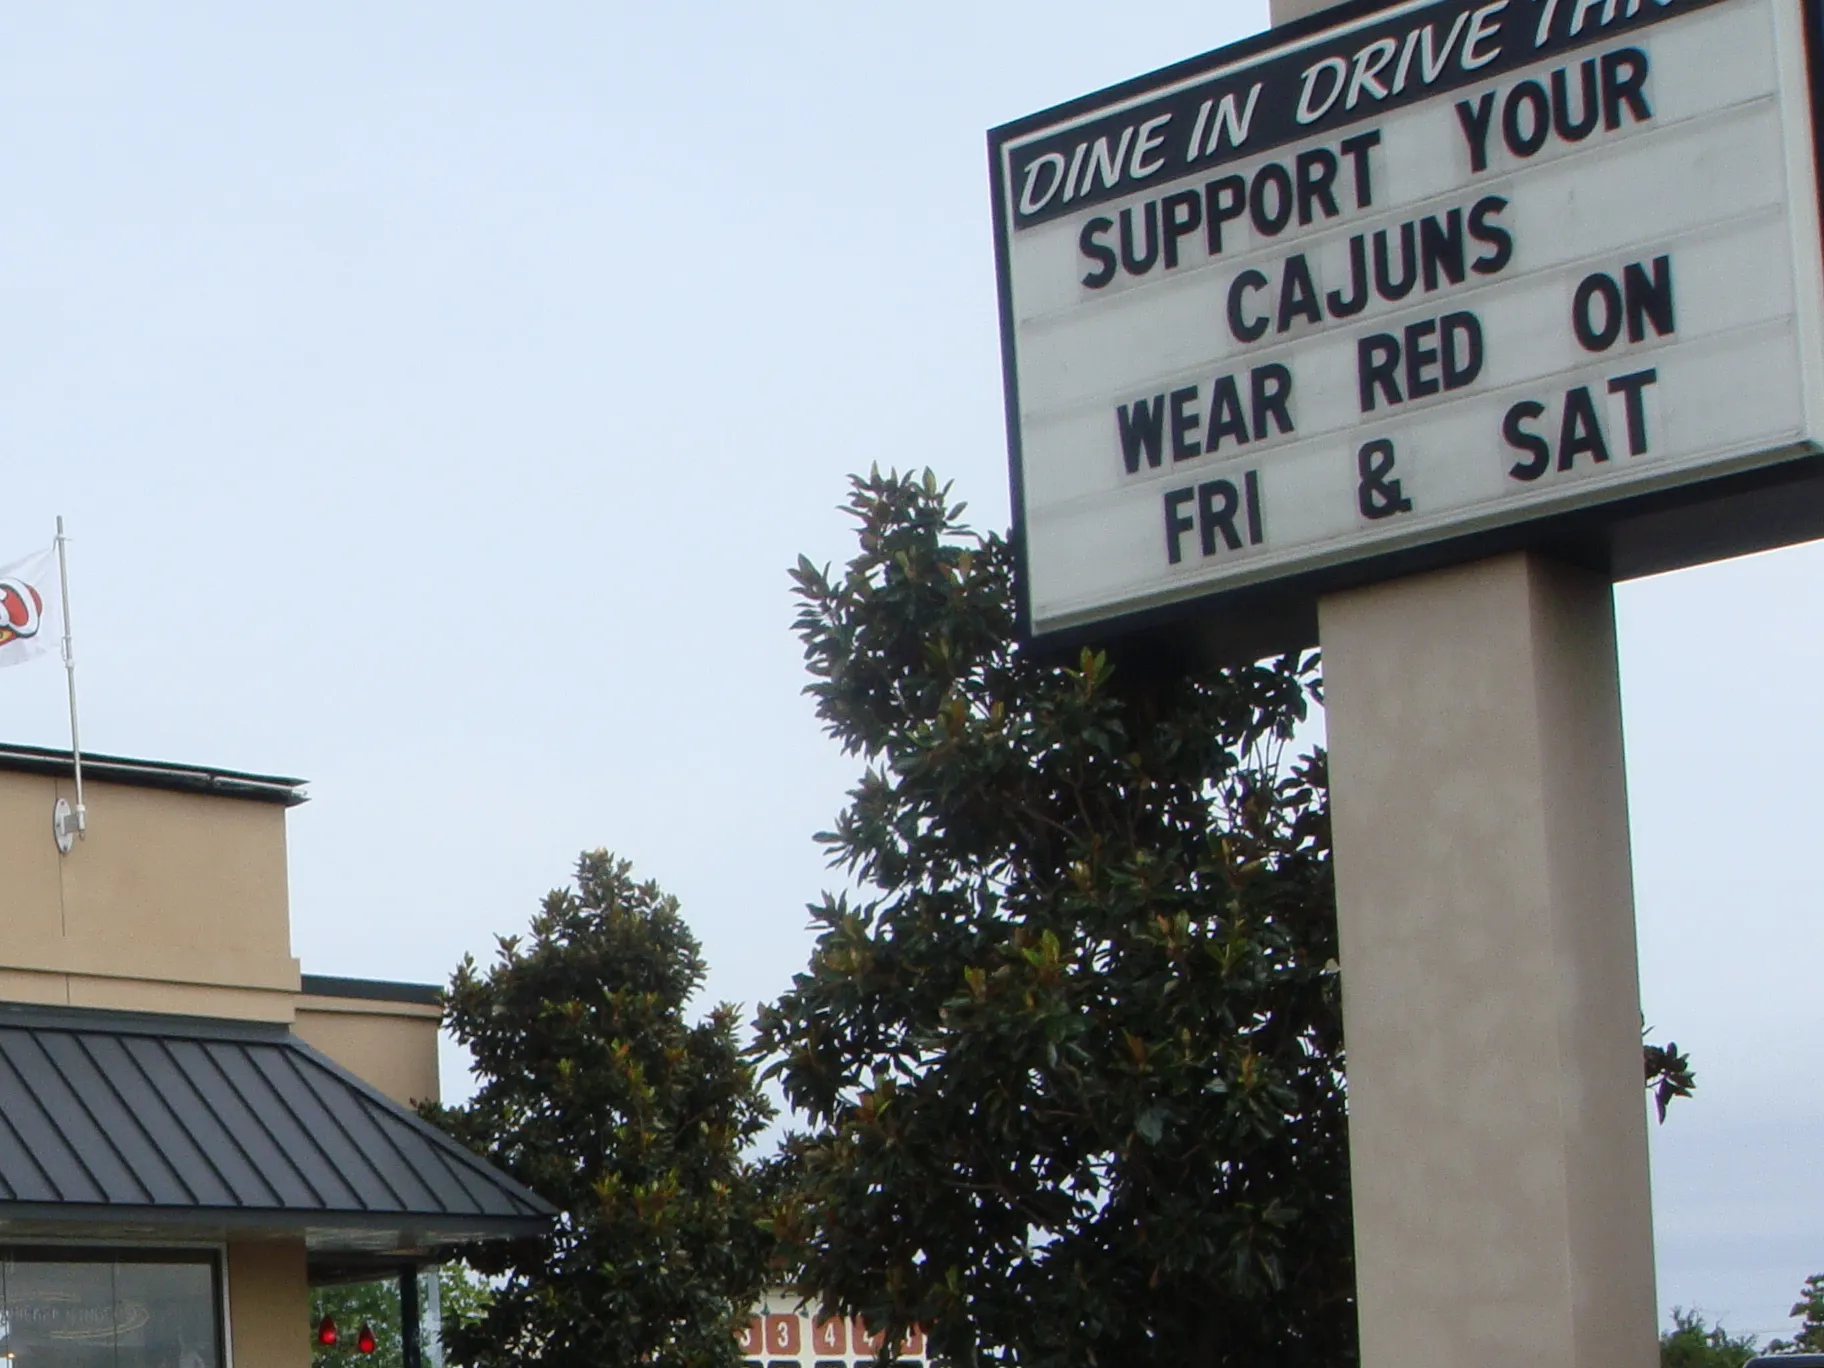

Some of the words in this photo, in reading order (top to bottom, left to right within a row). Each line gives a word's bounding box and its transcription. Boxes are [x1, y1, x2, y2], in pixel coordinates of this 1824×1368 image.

[1020, 119, 1172, 216] DINE
[1186, 83, 1262, 158] IN
[1295, 0, 1503, 126] DRIVE
[1078, 129, 1380, 290] SUPPORT
[1455, 46, 1652, 174] YOUR
[1115, 362, 1294, 474] WEAR
[1357, 310, 1483, 413] RED
[1575, 255, 1674, 353] ON
[1226, 195, 1514, 344] CAJUNS
[1163, 470, 1263, 565] FRI
[1358, 438, 1412, 520] &
[1503, 369, 1657, 482] SAT
